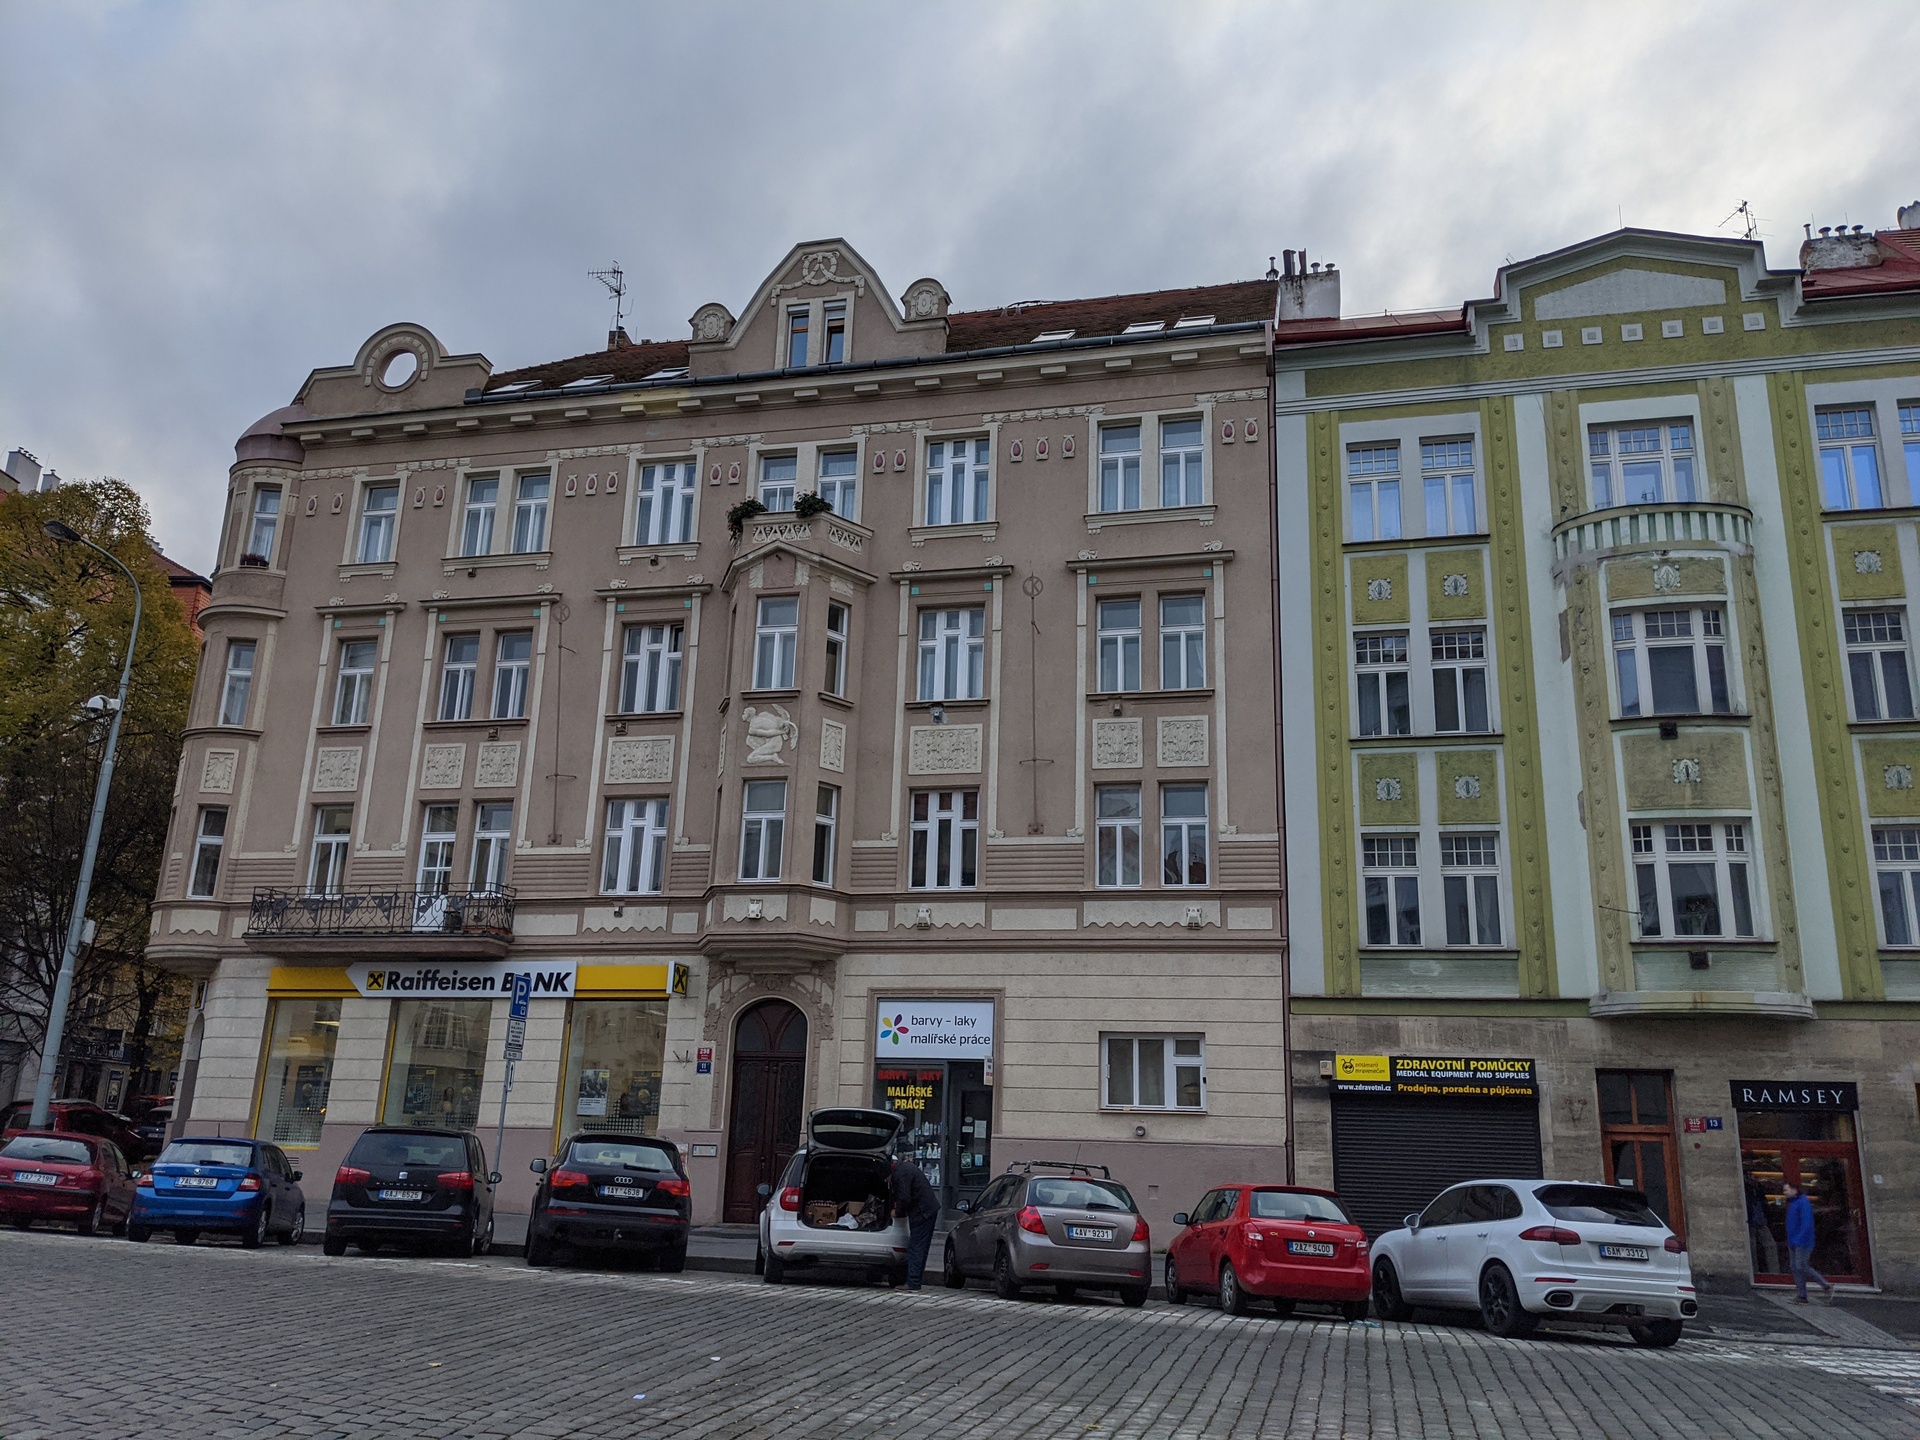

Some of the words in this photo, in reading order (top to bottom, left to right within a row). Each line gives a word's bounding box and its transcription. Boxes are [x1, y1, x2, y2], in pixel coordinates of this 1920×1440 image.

[386, 968, 495, 991] Raiffeisen
[501, 971, 572, 993] BNK
[515, 980, 527, 1005] P
[911, 1015, 943, 1028] barvy
[954, 1015, 977, 1028] laky
[910, 1033, 957, 1045] malířské
[959, 1034, 991, 1046] práce
[1396, 1058, 1466, 1071] ZDRAVOTNÍ
[1470, 1059, 1531, 1072] POMŮCKY
[917, 1069, 943, 1081] LAKY
[1431, 1071, 1474, 1079] EQUIPMENT
[887, 1085, 933, 1098] MALÍŘSKÉ
[1337, 1083, 1392, 1092] www.zdravotni.cz
[1397, 1083, 1441, 1094] Prodejna,
[1443, 1084, 1481, 1095] poradna
[1490, 1085, 1532, 1096] půjčovna
[1742, 1088, 1844, 1105] RAMSEY
[894, 1099, 926, 1110] PRÁCE
[1709, 1119, 1719, 1127] 13
[384, 1190, 398, 1198] 6AJ
[401, 1191, 419, 1199] 6525
[607, 1186, 619, 1194] 1AY
[1074, 1228, 1088, 1237] 4AV
[1092, 1229, 1110, 1239] 9231
[1294, 1242, 1308, 1252] 2AZ
[1312, 1244, 1331, 1253] 9400
[1606, 1246, 1621, 1256] 6AM
[1626, 1248, 1645, 1258] 3312
